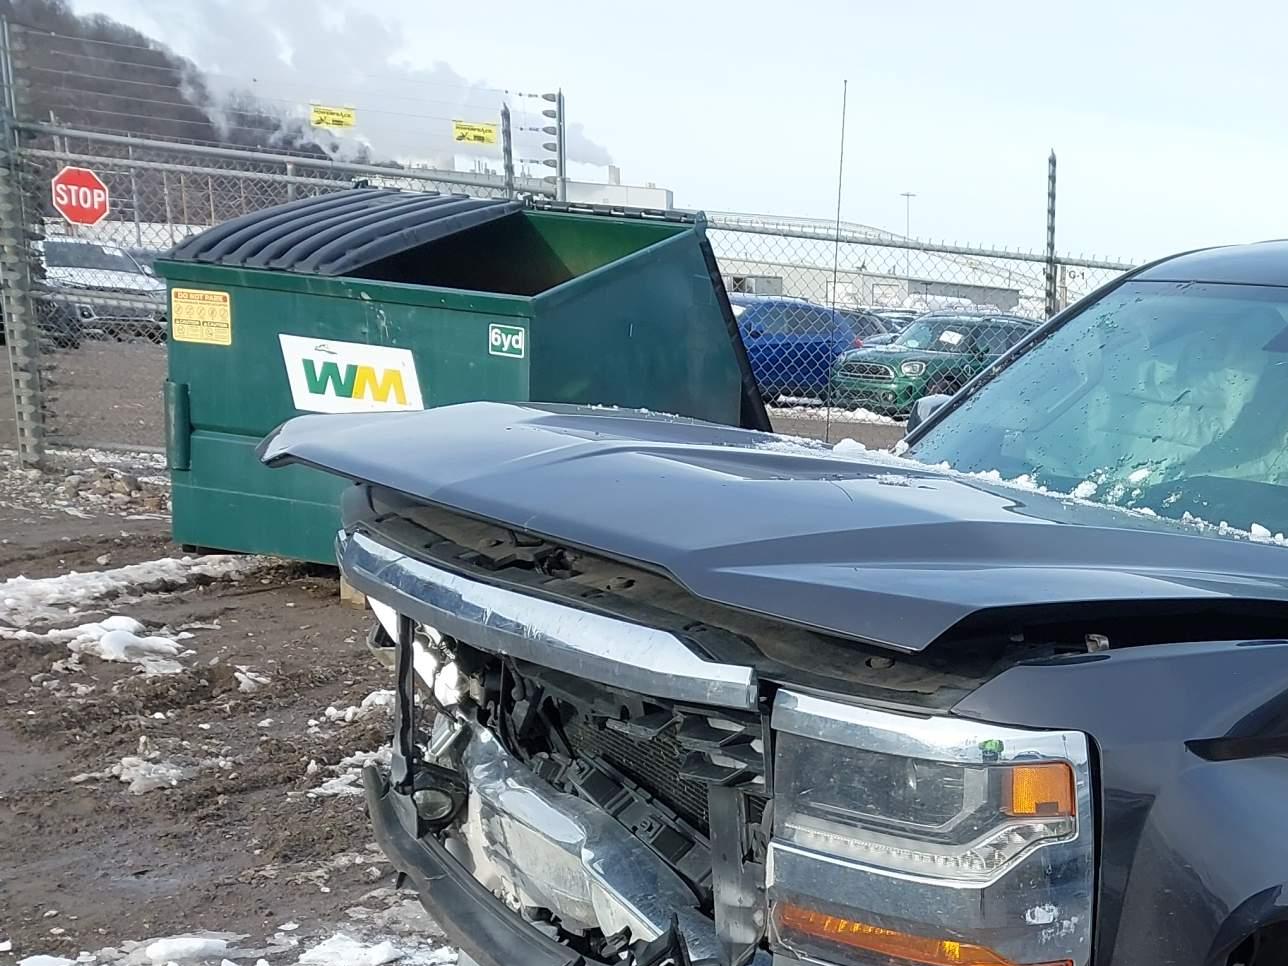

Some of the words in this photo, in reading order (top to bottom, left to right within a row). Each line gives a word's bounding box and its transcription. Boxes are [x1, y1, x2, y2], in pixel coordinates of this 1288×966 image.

[56, 183, 105, 209] STOP
[491, 328, 523, 352] 6yd
[302, 358, 408, 406] WM
